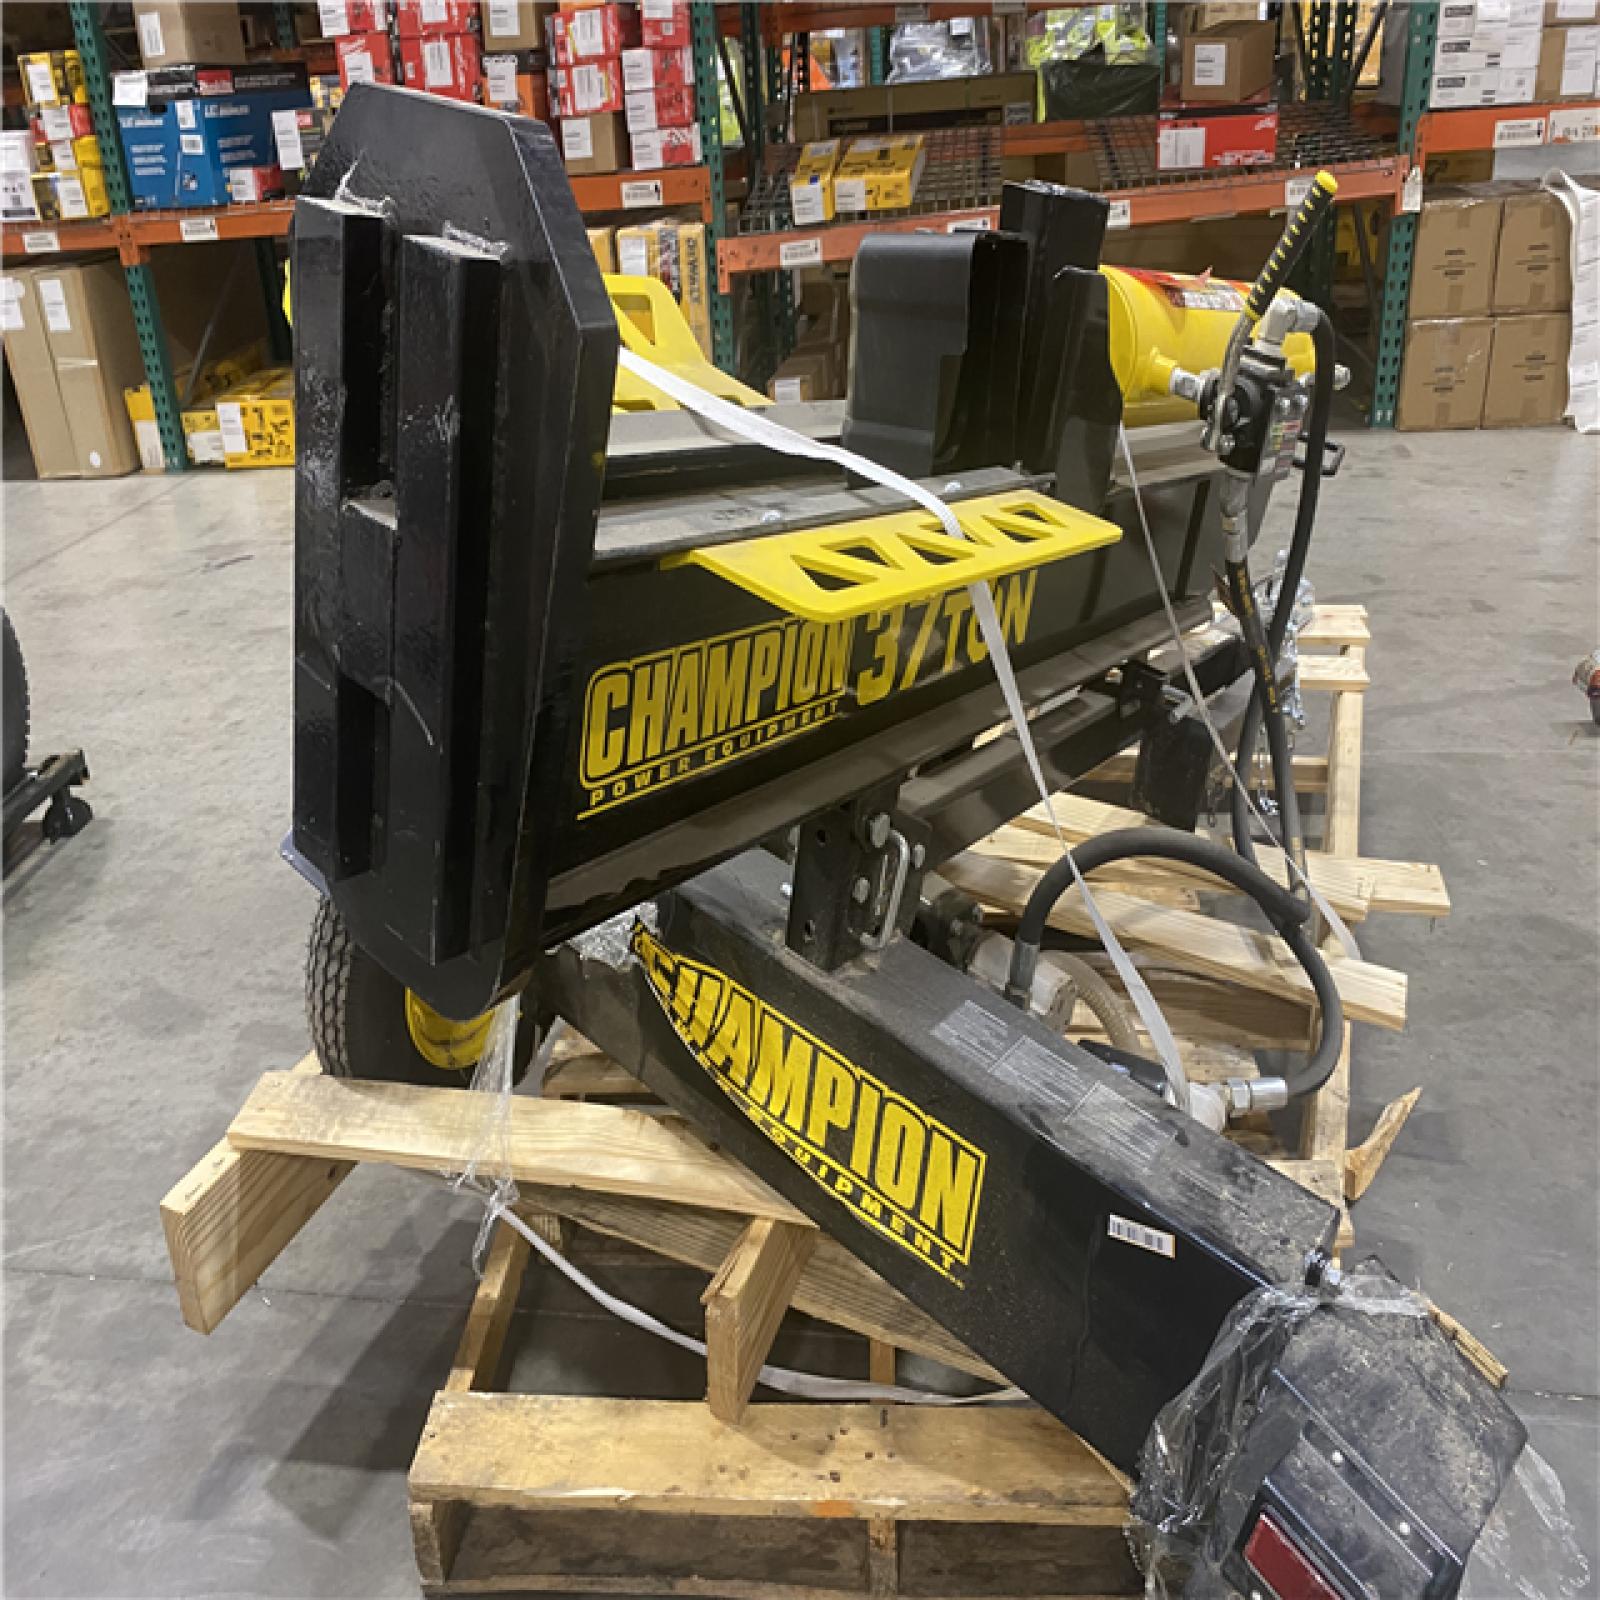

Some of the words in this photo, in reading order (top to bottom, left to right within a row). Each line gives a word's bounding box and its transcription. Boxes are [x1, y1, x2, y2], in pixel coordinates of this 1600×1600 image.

[586, 618, 849, 779] CHAMPION
[857, 593, 944, 705] 37
[943, 569, 1038, 673] TON
[589, 757, 691, 806] POWER
[704, 699, 839, 762] EQUIPMENT
[637, 930, 978, 1250] CHAMPION
